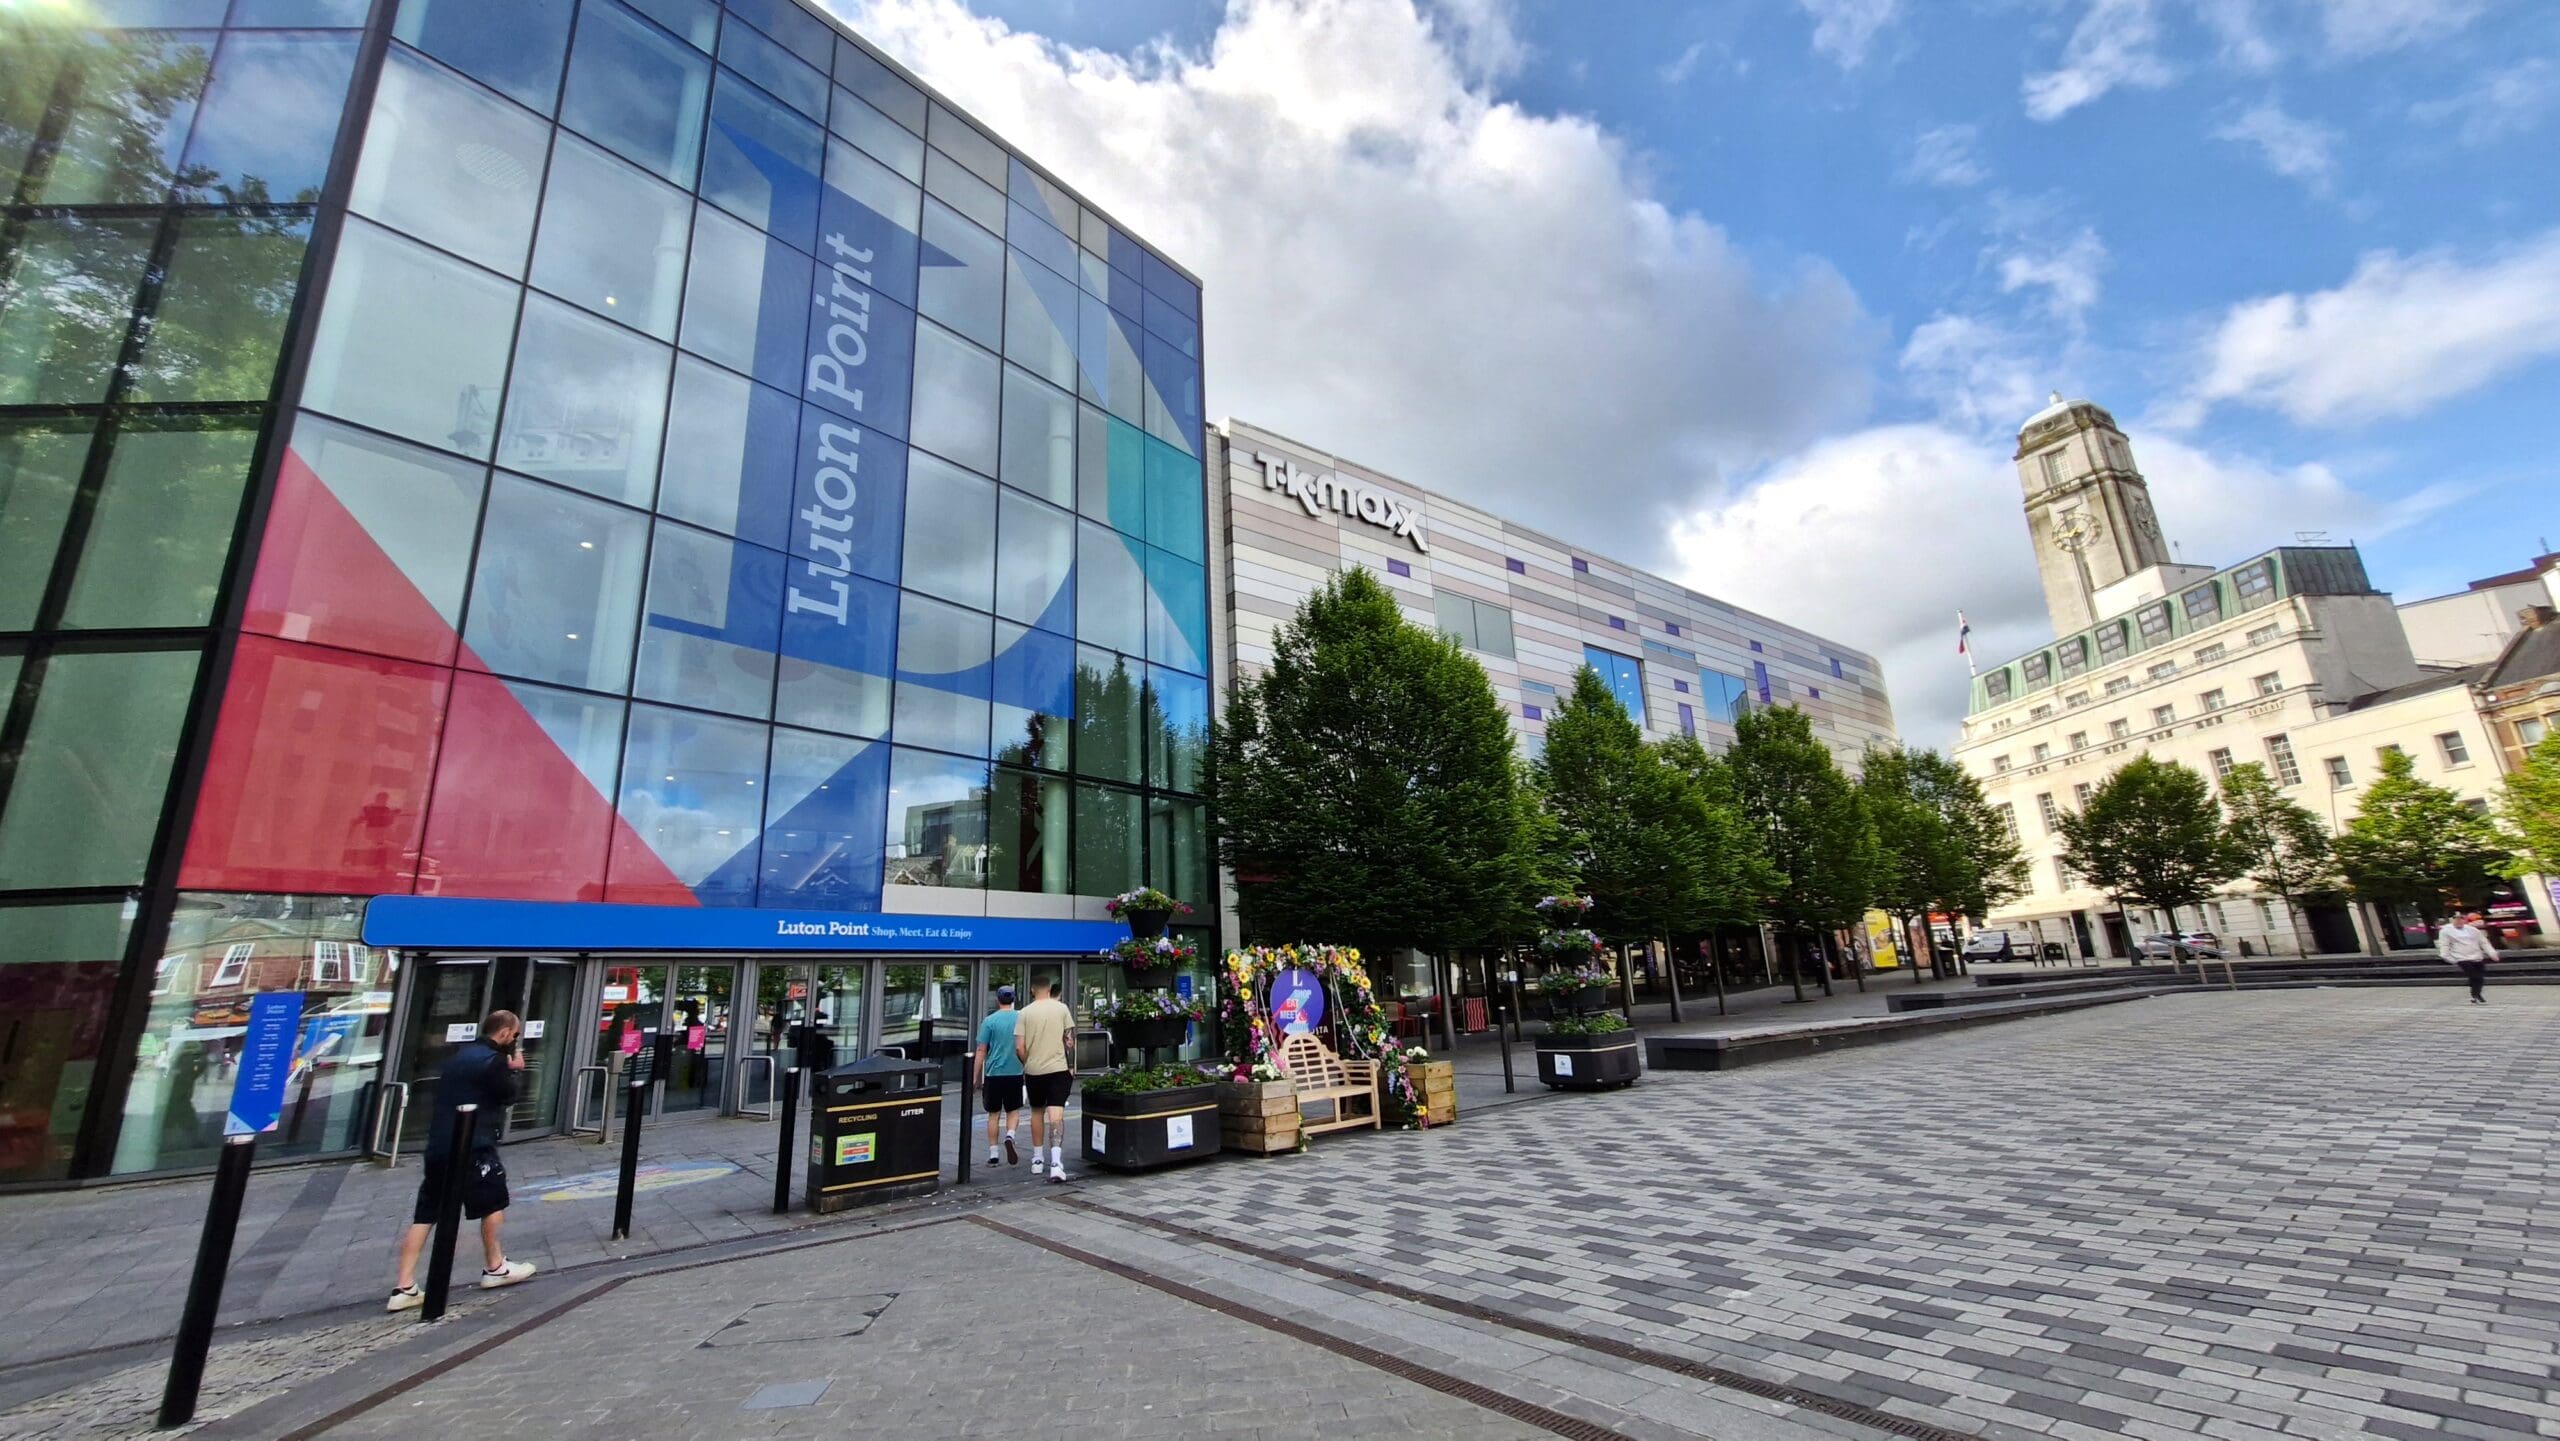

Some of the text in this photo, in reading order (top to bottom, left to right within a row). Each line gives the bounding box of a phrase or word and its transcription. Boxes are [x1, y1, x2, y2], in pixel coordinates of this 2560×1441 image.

[788, 232, 873, 625] Luton Point
[777, 920, 972, 940] Luton Point Shop, Meet, Eat & Enjoy
[838, 1113, 878, 1124] RECYCLING
[901, 1108, 924, 1117] LITTER
